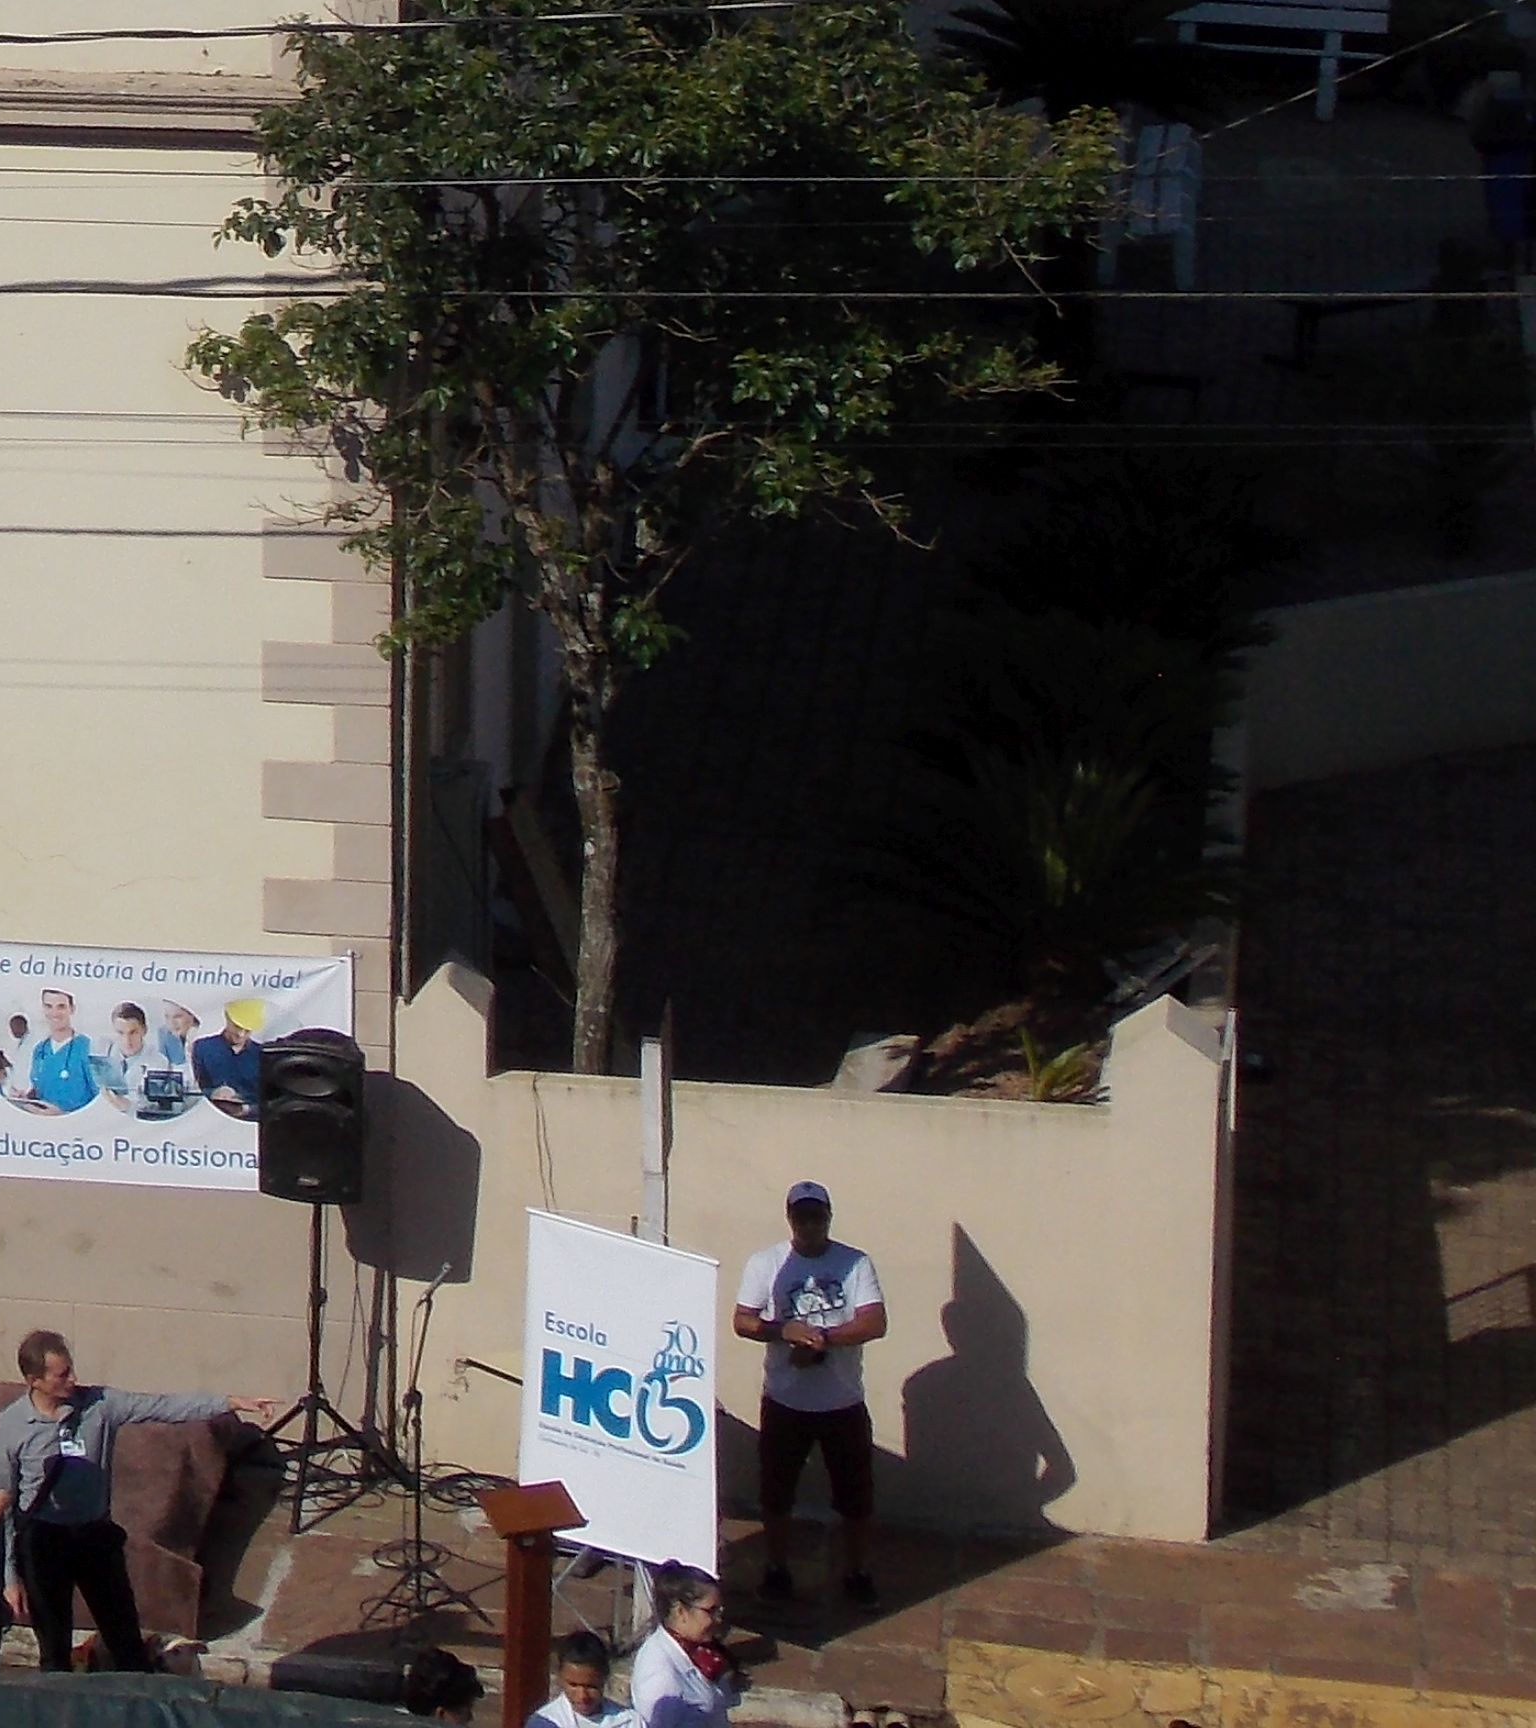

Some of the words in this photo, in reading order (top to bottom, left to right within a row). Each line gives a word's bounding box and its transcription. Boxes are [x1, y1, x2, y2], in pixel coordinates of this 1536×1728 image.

[20, 954, 45, 975] da
[53, 954, 134, 981] história
[141, 961, 168, 982] da
[175, 964, 244, 987] minha
[251, 968, 302, 989] vida!
[113, 1138, 259, 1169] Profissiona
[544, 1311, 608, 1346] Escola
[659, 1320, 697, 1357] 50
[653, 1352, 705, 1377] anos
